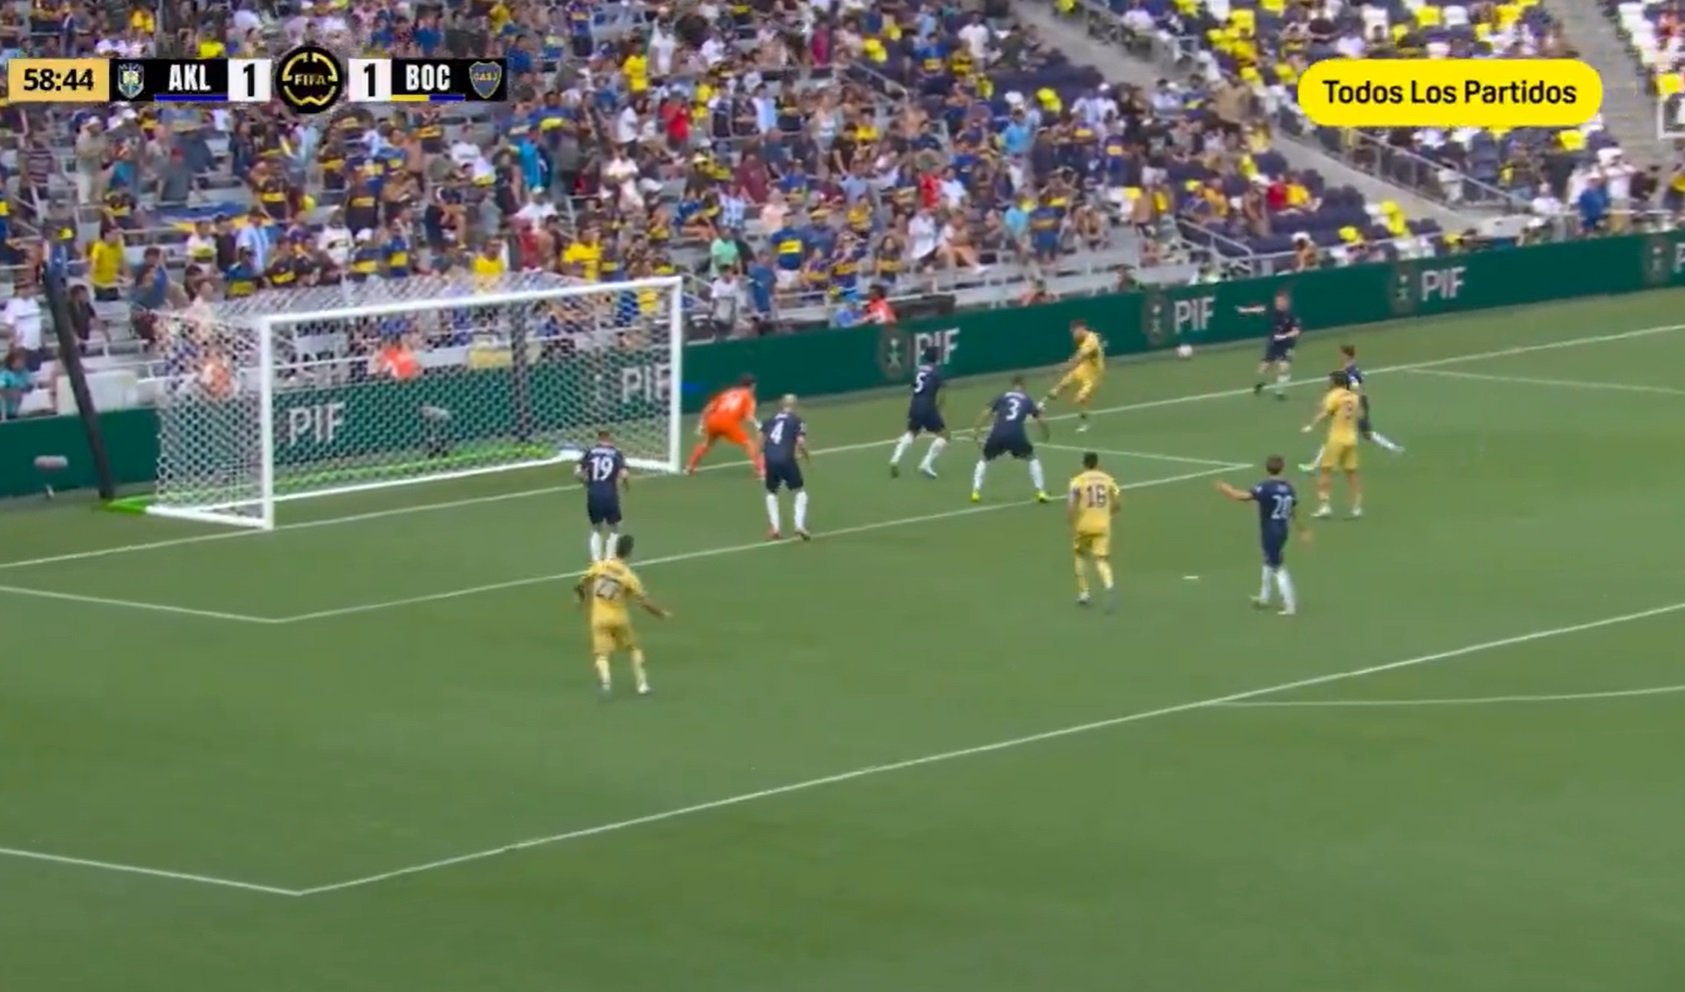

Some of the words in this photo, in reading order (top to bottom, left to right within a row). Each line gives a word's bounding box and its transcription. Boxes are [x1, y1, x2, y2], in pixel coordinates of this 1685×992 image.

[1421, 266, 1466, 300] PIF
[1173, 297, 1214, 332] PIF
[914, 372, 925, 393] 5
[1006, 399, 1021, 421] 3
[288, 401, 346, 446] PIF
[770, 420, 784, 444] 4
[592, 457, 614, 482] 19
[1086, 483, 1108, 508] 16
[1271, 494, 1293, 520] 20
